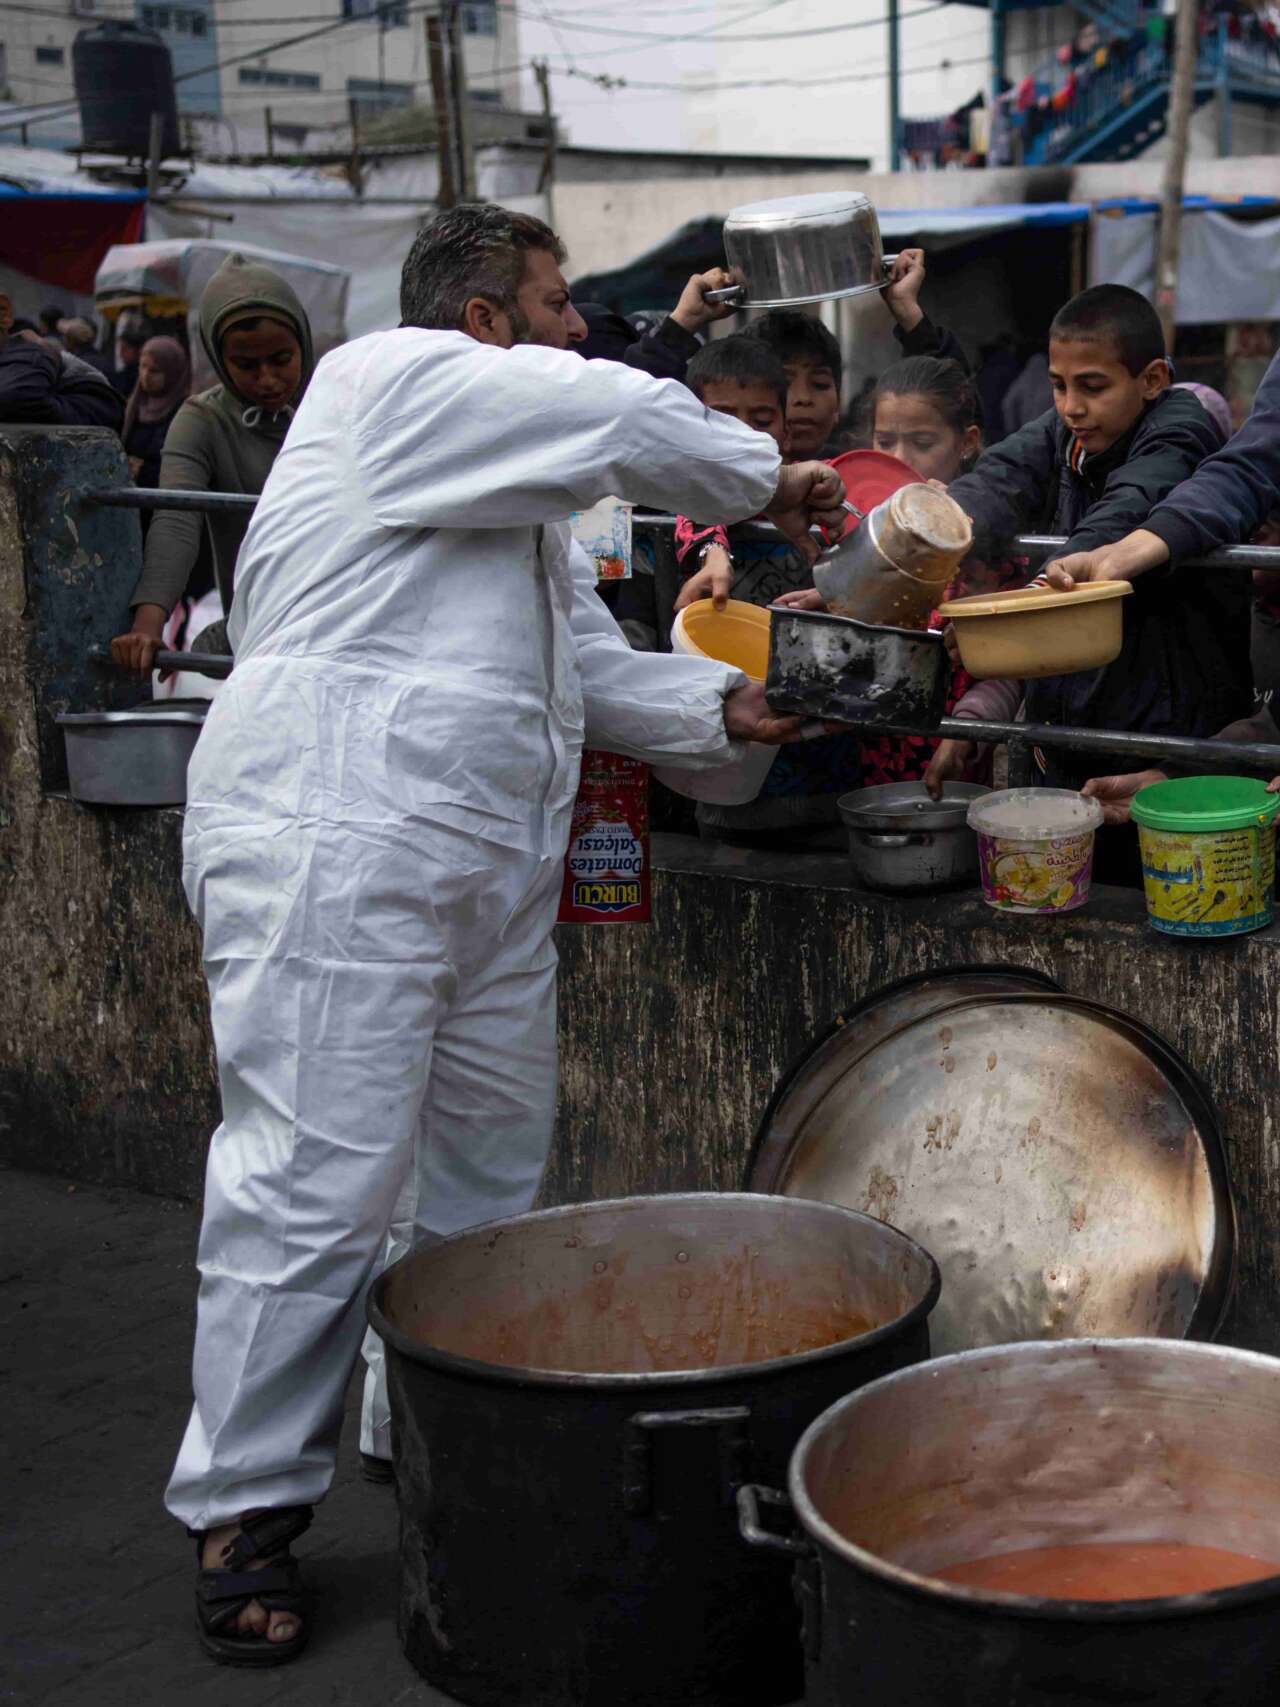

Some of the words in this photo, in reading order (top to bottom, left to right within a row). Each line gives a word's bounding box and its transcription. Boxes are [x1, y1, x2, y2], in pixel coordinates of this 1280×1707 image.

[578, 835, 636, 855] Salçası
[571, 857, 642, 874] Domates
[578, 884, 638, 904] BURCU
